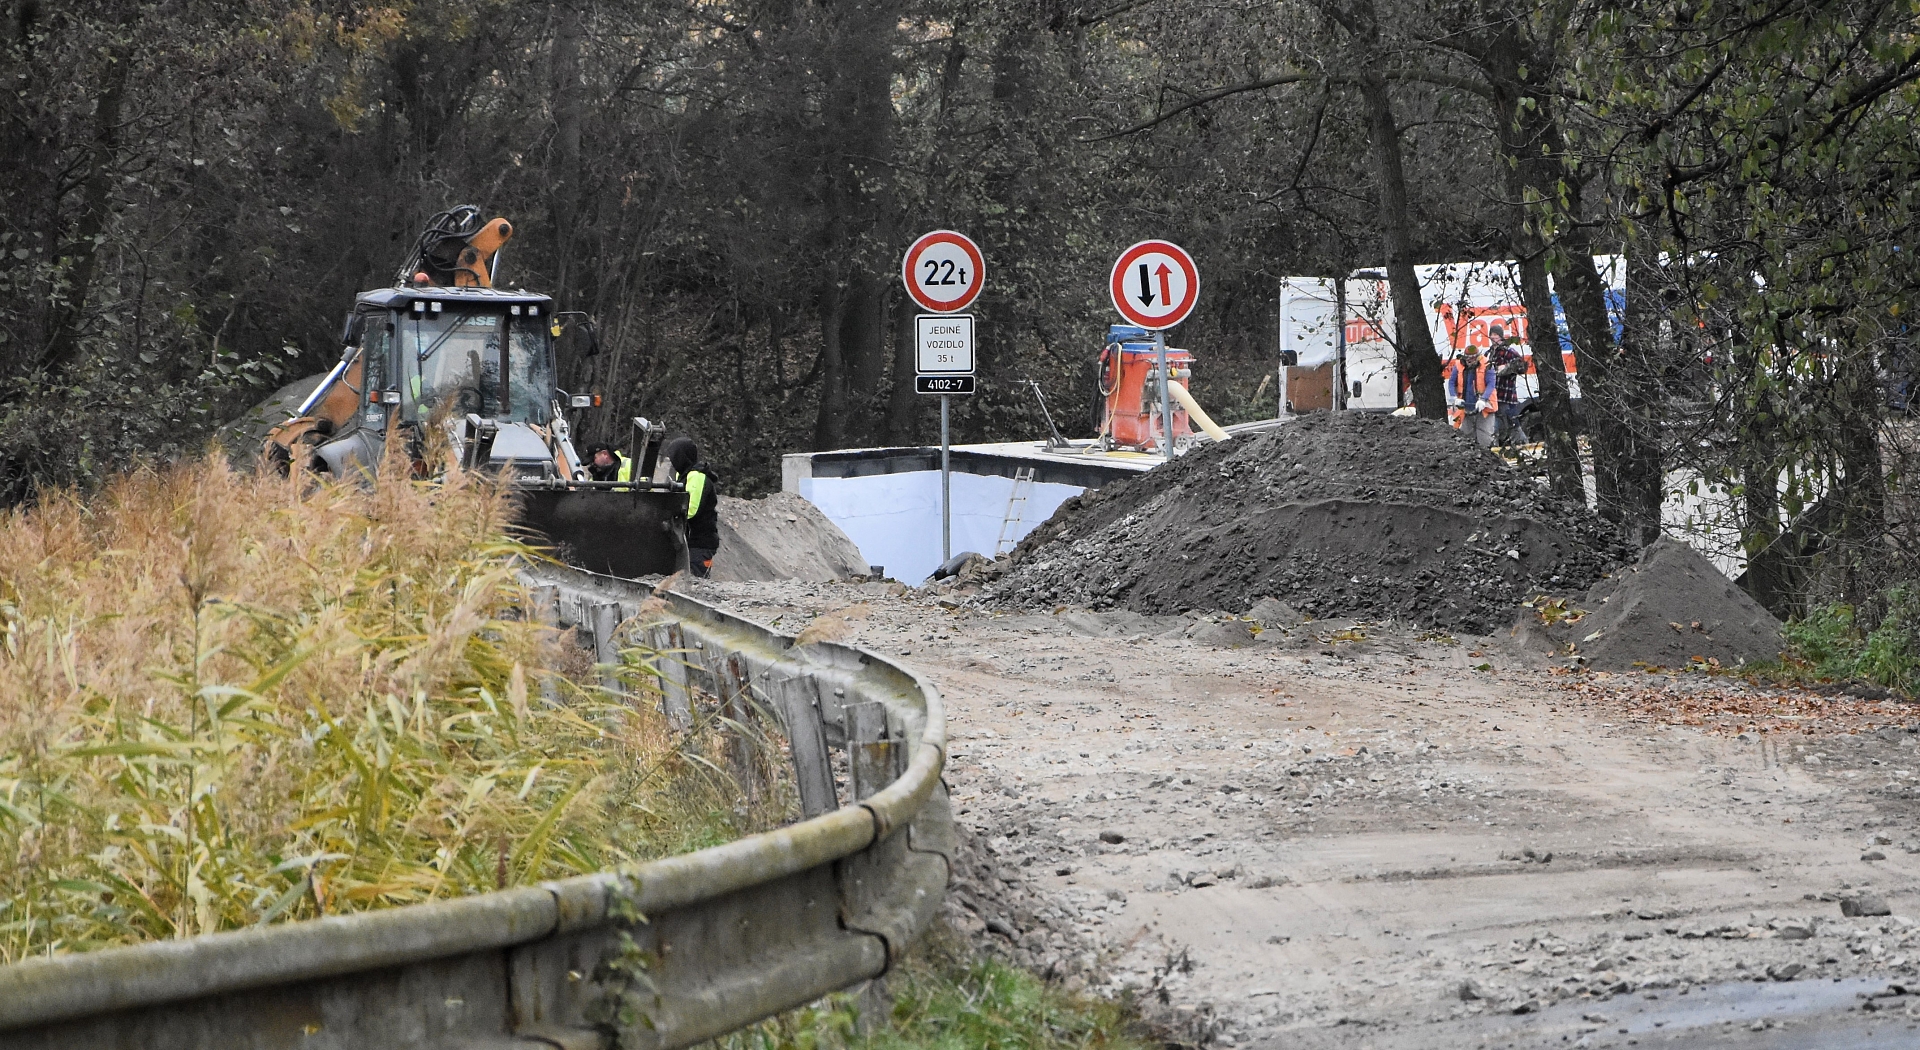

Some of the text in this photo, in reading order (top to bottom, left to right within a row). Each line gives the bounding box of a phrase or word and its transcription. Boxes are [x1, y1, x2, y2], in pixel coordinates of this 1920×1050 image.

[928, 323, 961, 335] JEDINÉ
[926, 340, 964, 349] VOZIDLO
[937, 354, 955, 363] 35 t
[927, 379, 963, 390] 4102-7
